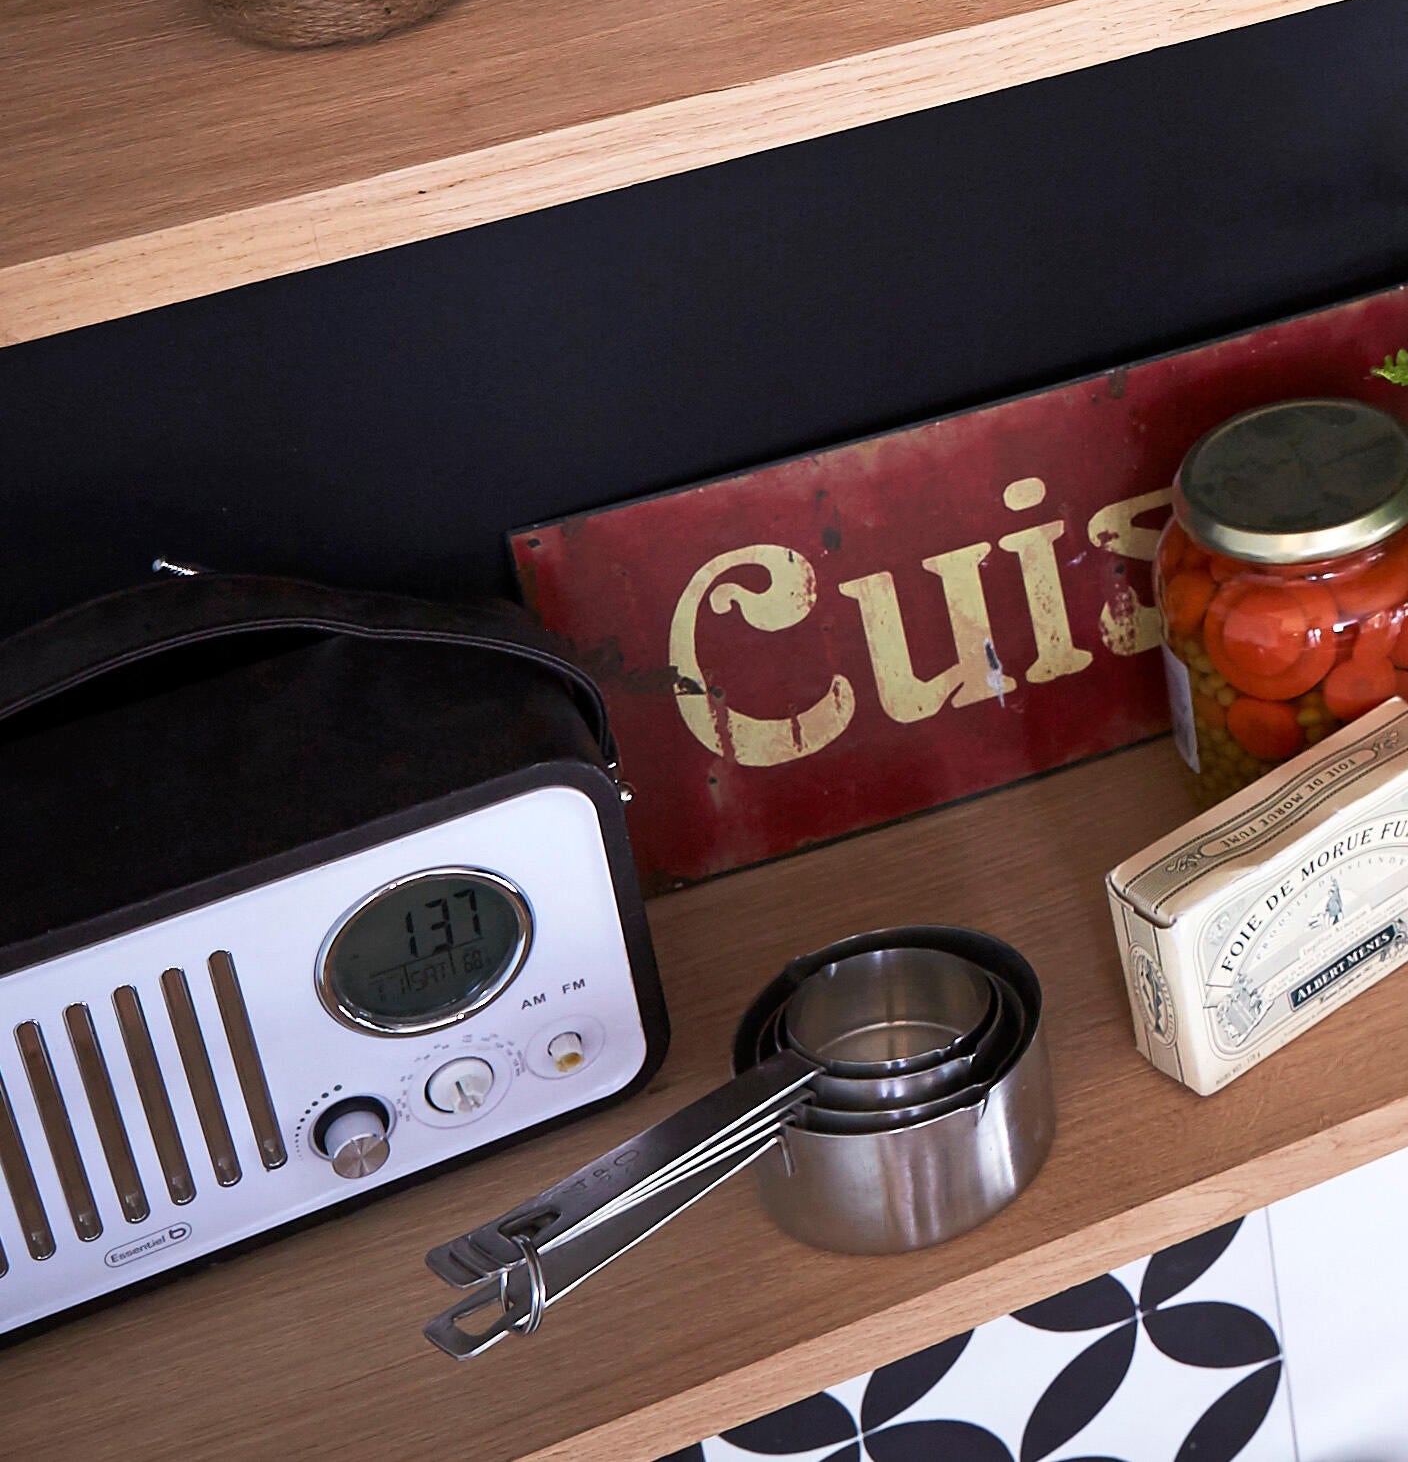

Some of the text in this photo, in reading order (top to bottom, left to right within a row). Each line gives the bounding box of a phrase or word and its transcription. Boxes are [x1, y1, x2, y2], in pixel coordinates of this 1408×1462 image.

[1306, 777, 1325, 792] DE
[1326, 758, 1357, 779] FOIE
[1258, 792, 1305, 826] MORUE
[1220, 917, 1263, 975] FOIE
[1264, 879, 1295, 913] DE
[1299, 826, 1374, 883] MORUE
[521, 978, 586, 1010] AM FM
[1296, 957, 1347, 1002] ALBERT
[110, 1235, 167, 1263] Essentiel
